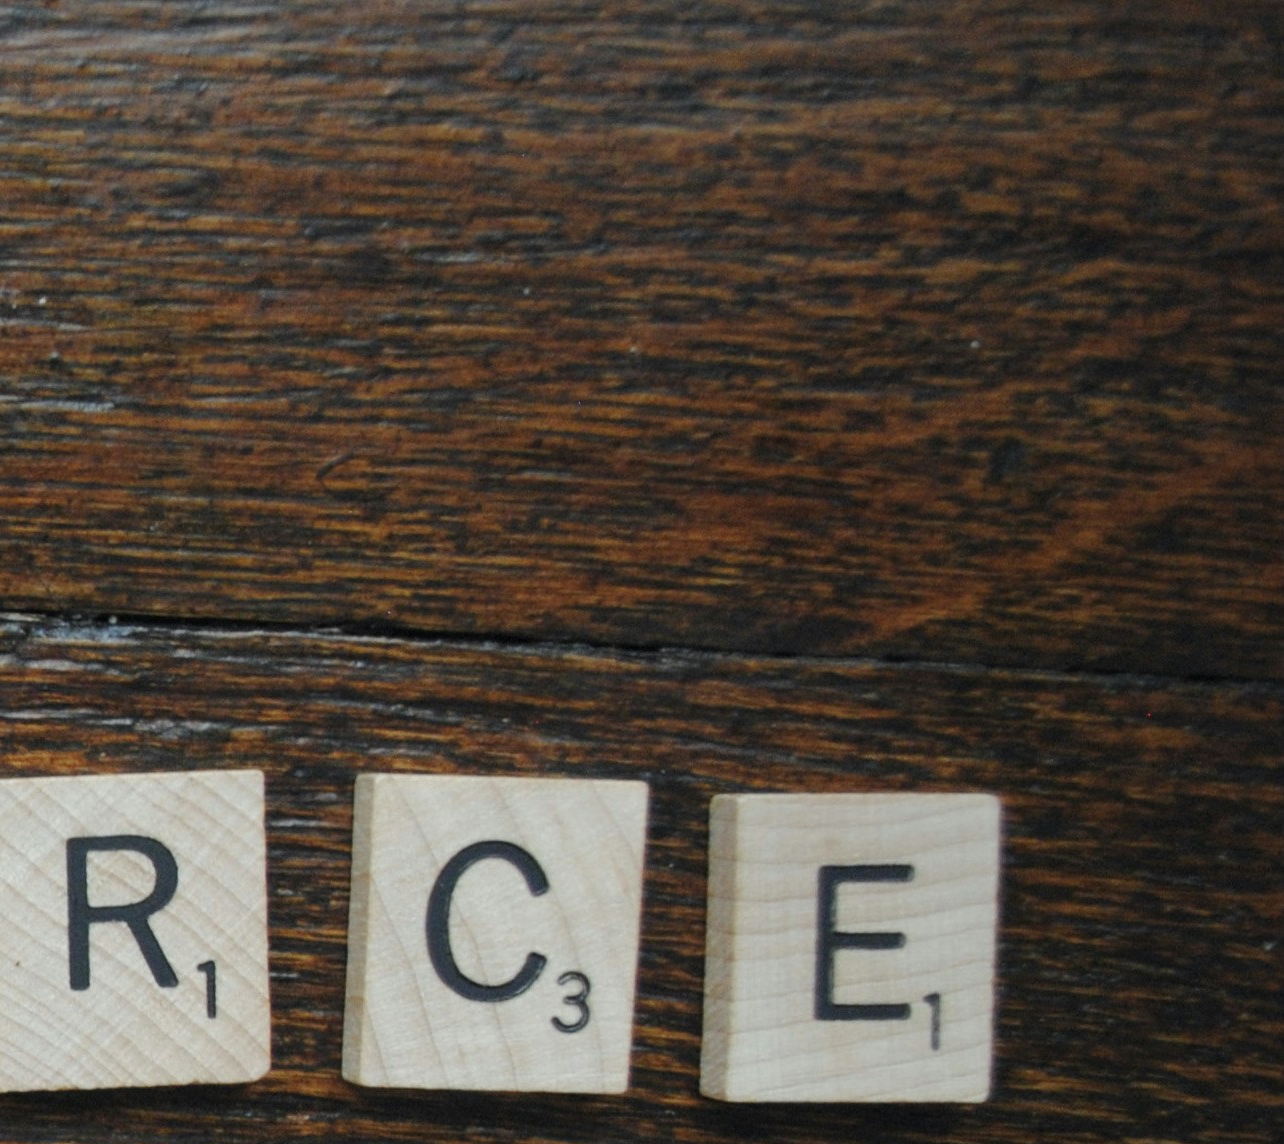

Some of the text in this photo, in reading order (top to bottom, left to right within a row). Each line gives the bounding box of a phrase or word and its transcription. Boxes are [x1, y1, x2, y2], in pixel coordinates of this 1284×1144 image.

[195, 958, 219, 1020] 1
[549, 969, 593, 1035] 3
[921, 991, 943, 1051] 1
